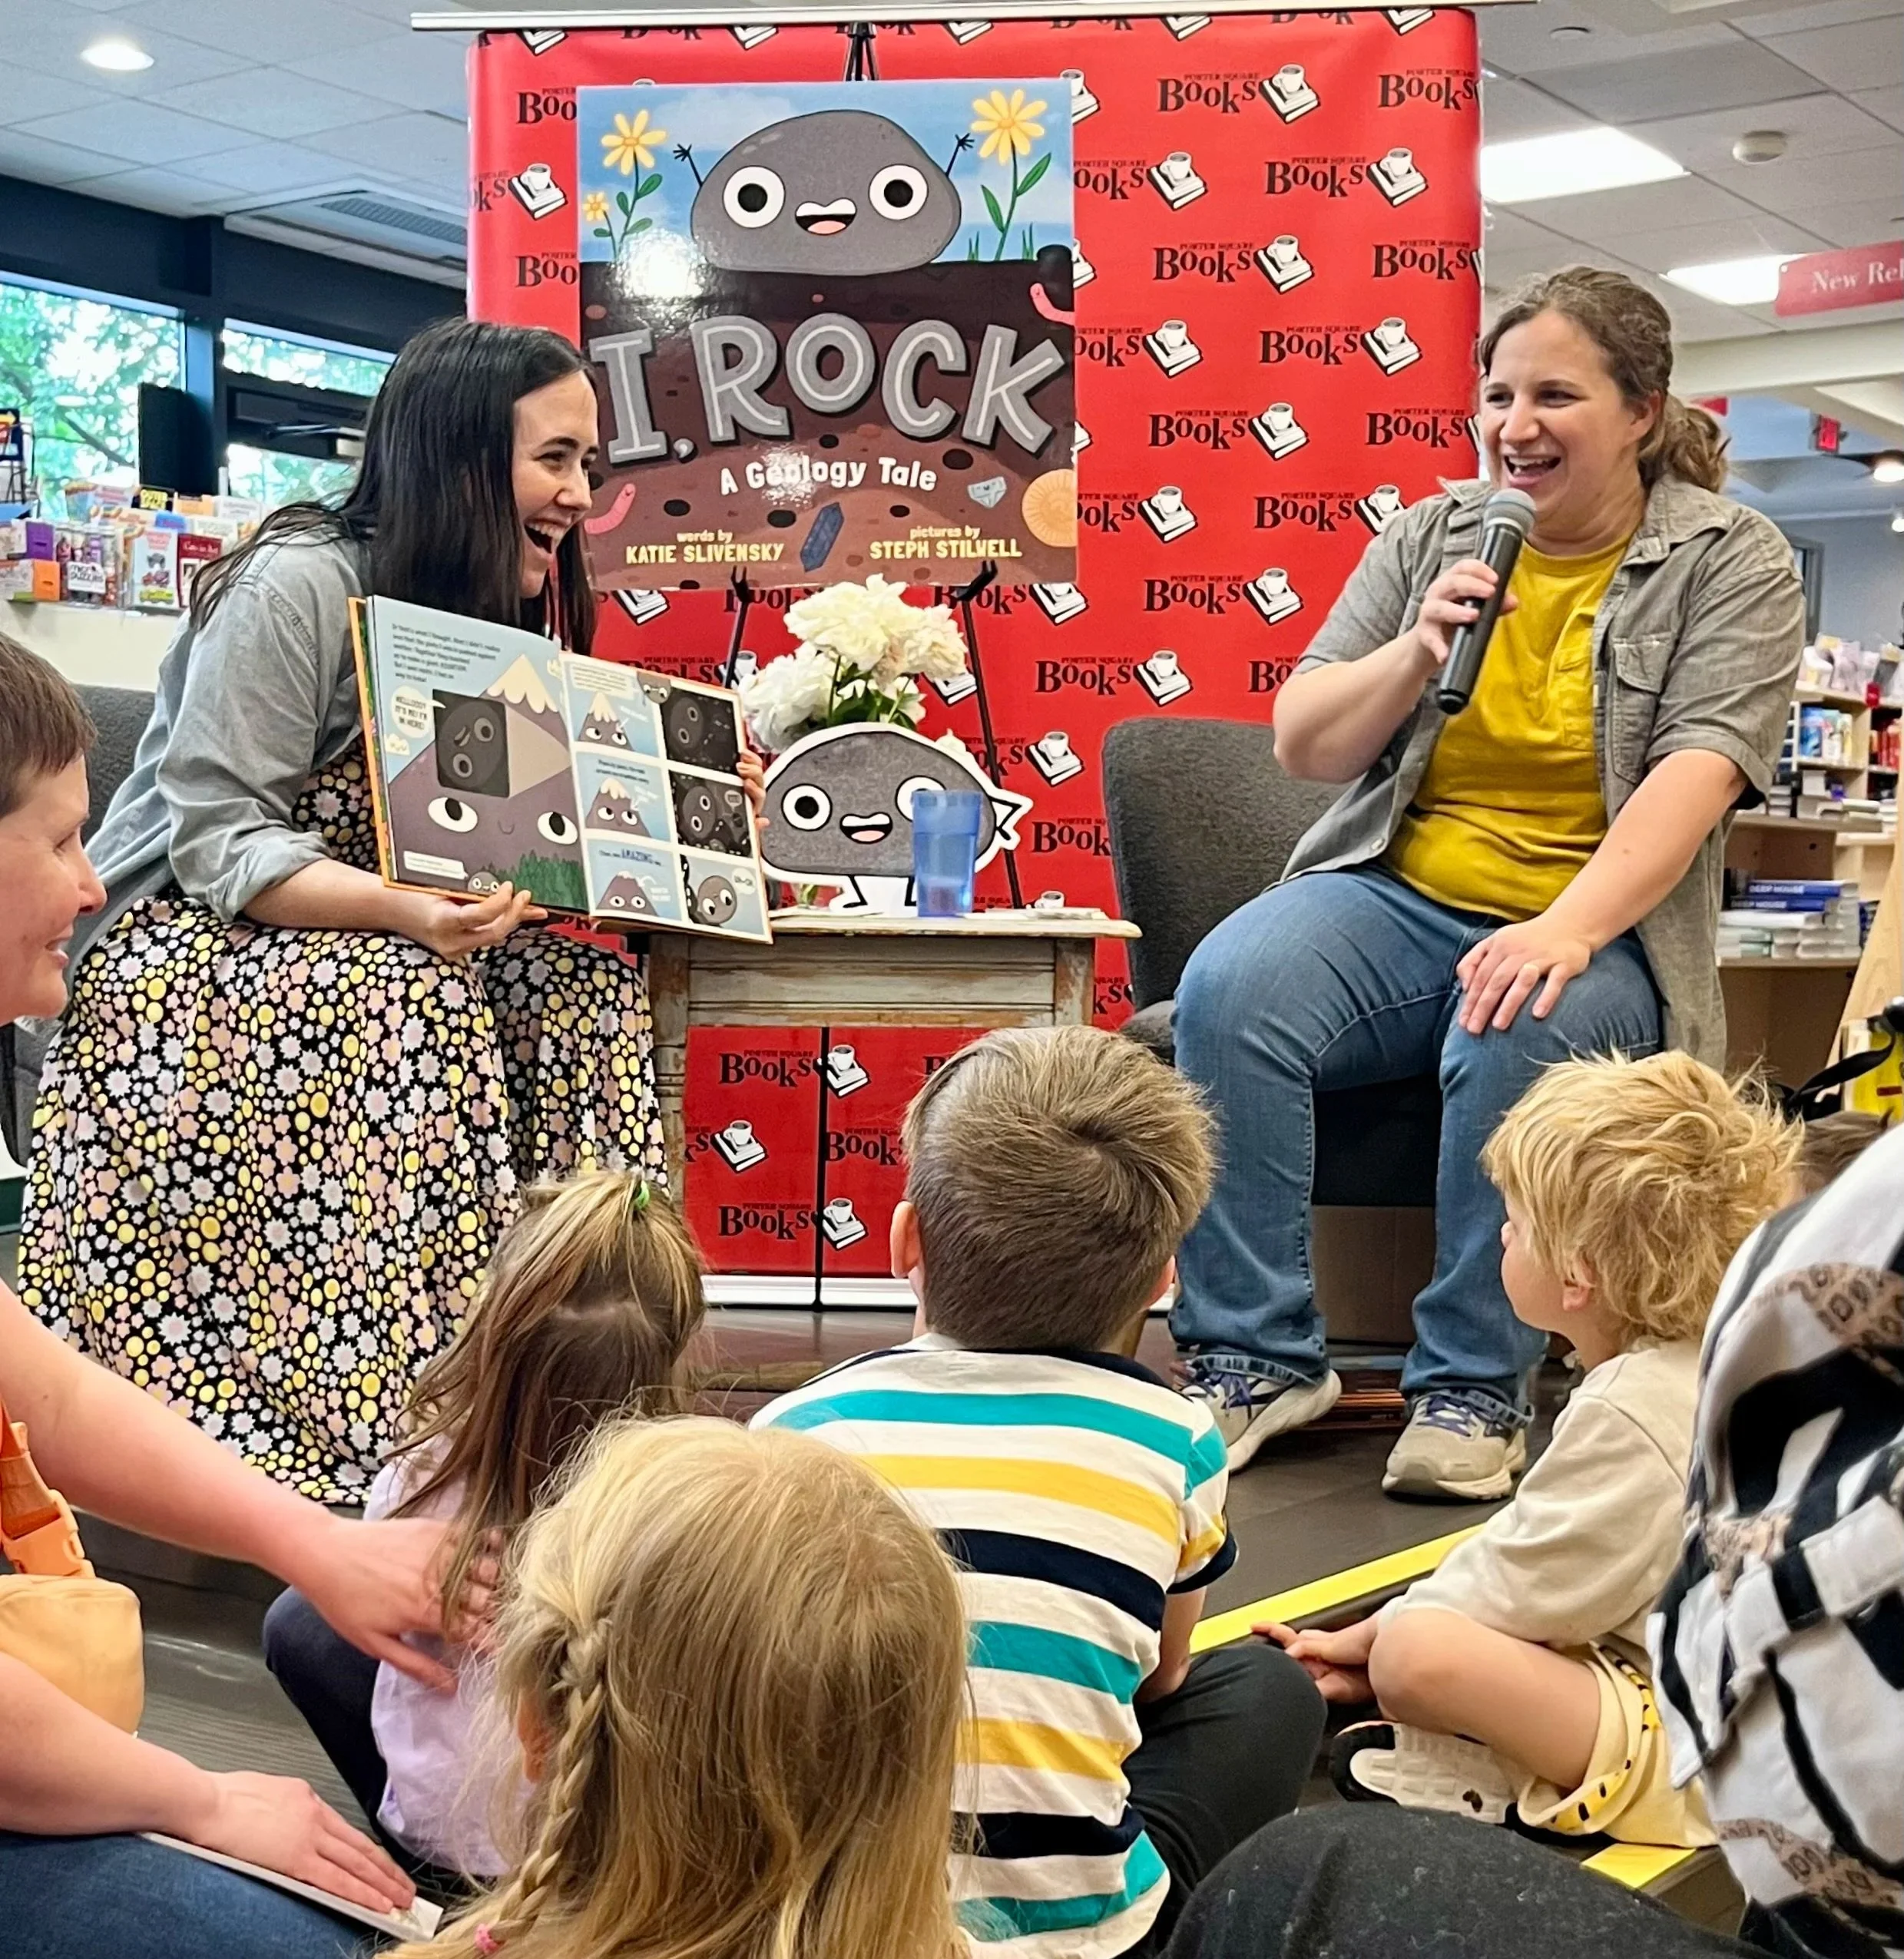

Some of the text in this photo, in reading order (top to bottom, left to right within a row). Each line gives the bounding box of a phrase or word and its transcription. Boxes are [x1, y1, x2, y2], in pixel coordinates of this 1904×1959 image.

[516, 91, 577, 124] Boo
[1157, 78, 1257, 113] Books
[1378, 75, 1474, 110] Books
[1074, 169, 1144, 200] ooks
[1264, 162, 1365, 197] Books
[515, 255, 577, 287] Boo
[1153, 248, 1251, 283] Books
[1373, 245, 1471, 281] Books
[1811, 270, 1858, 293] New
[1075, 335, 1141, 367] ooks
[1259, 331, 1359, 366] Books
[690, 313, 1065, 454] ROCK
[1149, 415, 1247, 450] Books
[1366, 414, 1463, 448] Books
[720, 455, 937, 495] A Geology Tale
[1255, 497, 1353, 531] Books
[677, 529, 733, 543] words by
[869, 538, 1022, 559] STEPH STILWELL
[910, 525, 981, 539] pictures by
[626, 544, 785, 564] KATIE SLIVENSKY
[1144, 581, 1240, 614] Books
[1035, 663, 1131, 696] Books
[1032, 822, 1111, 856] Book
[718, 1054, 812, 1088] Books
[826, 1133, 901, 1165] Book
[718, 1206, 812, 1240] Books
